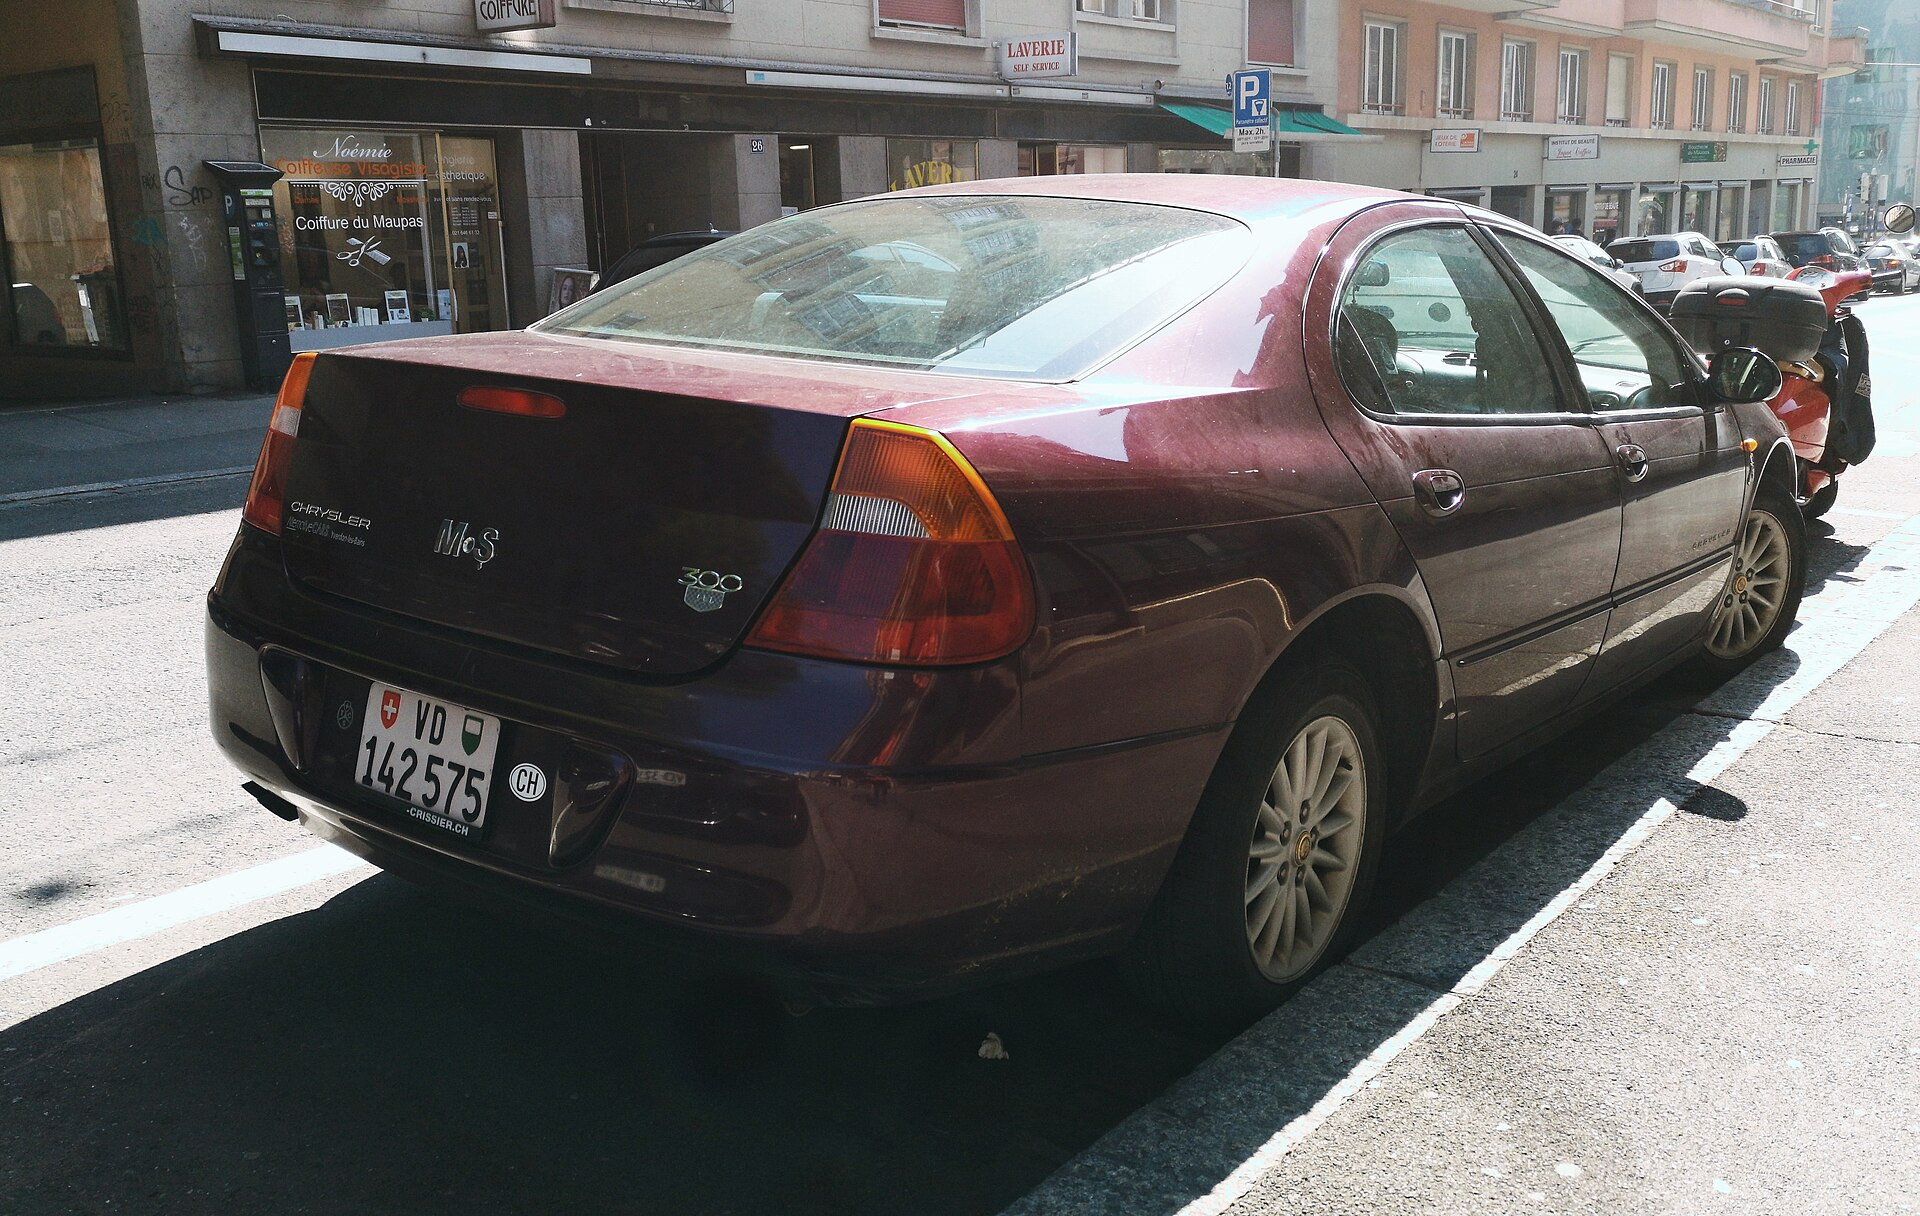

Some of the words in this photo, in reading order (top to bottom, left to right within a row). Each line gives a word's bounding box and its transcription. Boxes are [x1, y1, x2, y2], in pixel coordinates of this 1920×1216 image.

[1008, 40, 1065, 58] LAVERIE
[1013, 64, 1030, 73] SELF
[1032, 62, 1059, 72] SERVICE
[1240, 76, 1260, 110] P
[1239, 128, 1254, 136] Max.
[312, 135, 393, 159] Noémie
[752, 139, 763, 151] 26
[275, 157, 353, 176] Coiffeuse
[356, 160, 427, 179] Visagiste
[1781, 157, 1816, 165] PHARMACIE
[296, 216, 349, 230] Coiffure
[353, 215, 370, 229] du
[373, 215, 424, 231] Maupas
[290, 501, 371, 530] CHRYSLER
[678, 566, 743, 592] 300
[415, 700, 447, 746] VD
[516, 768, 539, 796] CH
